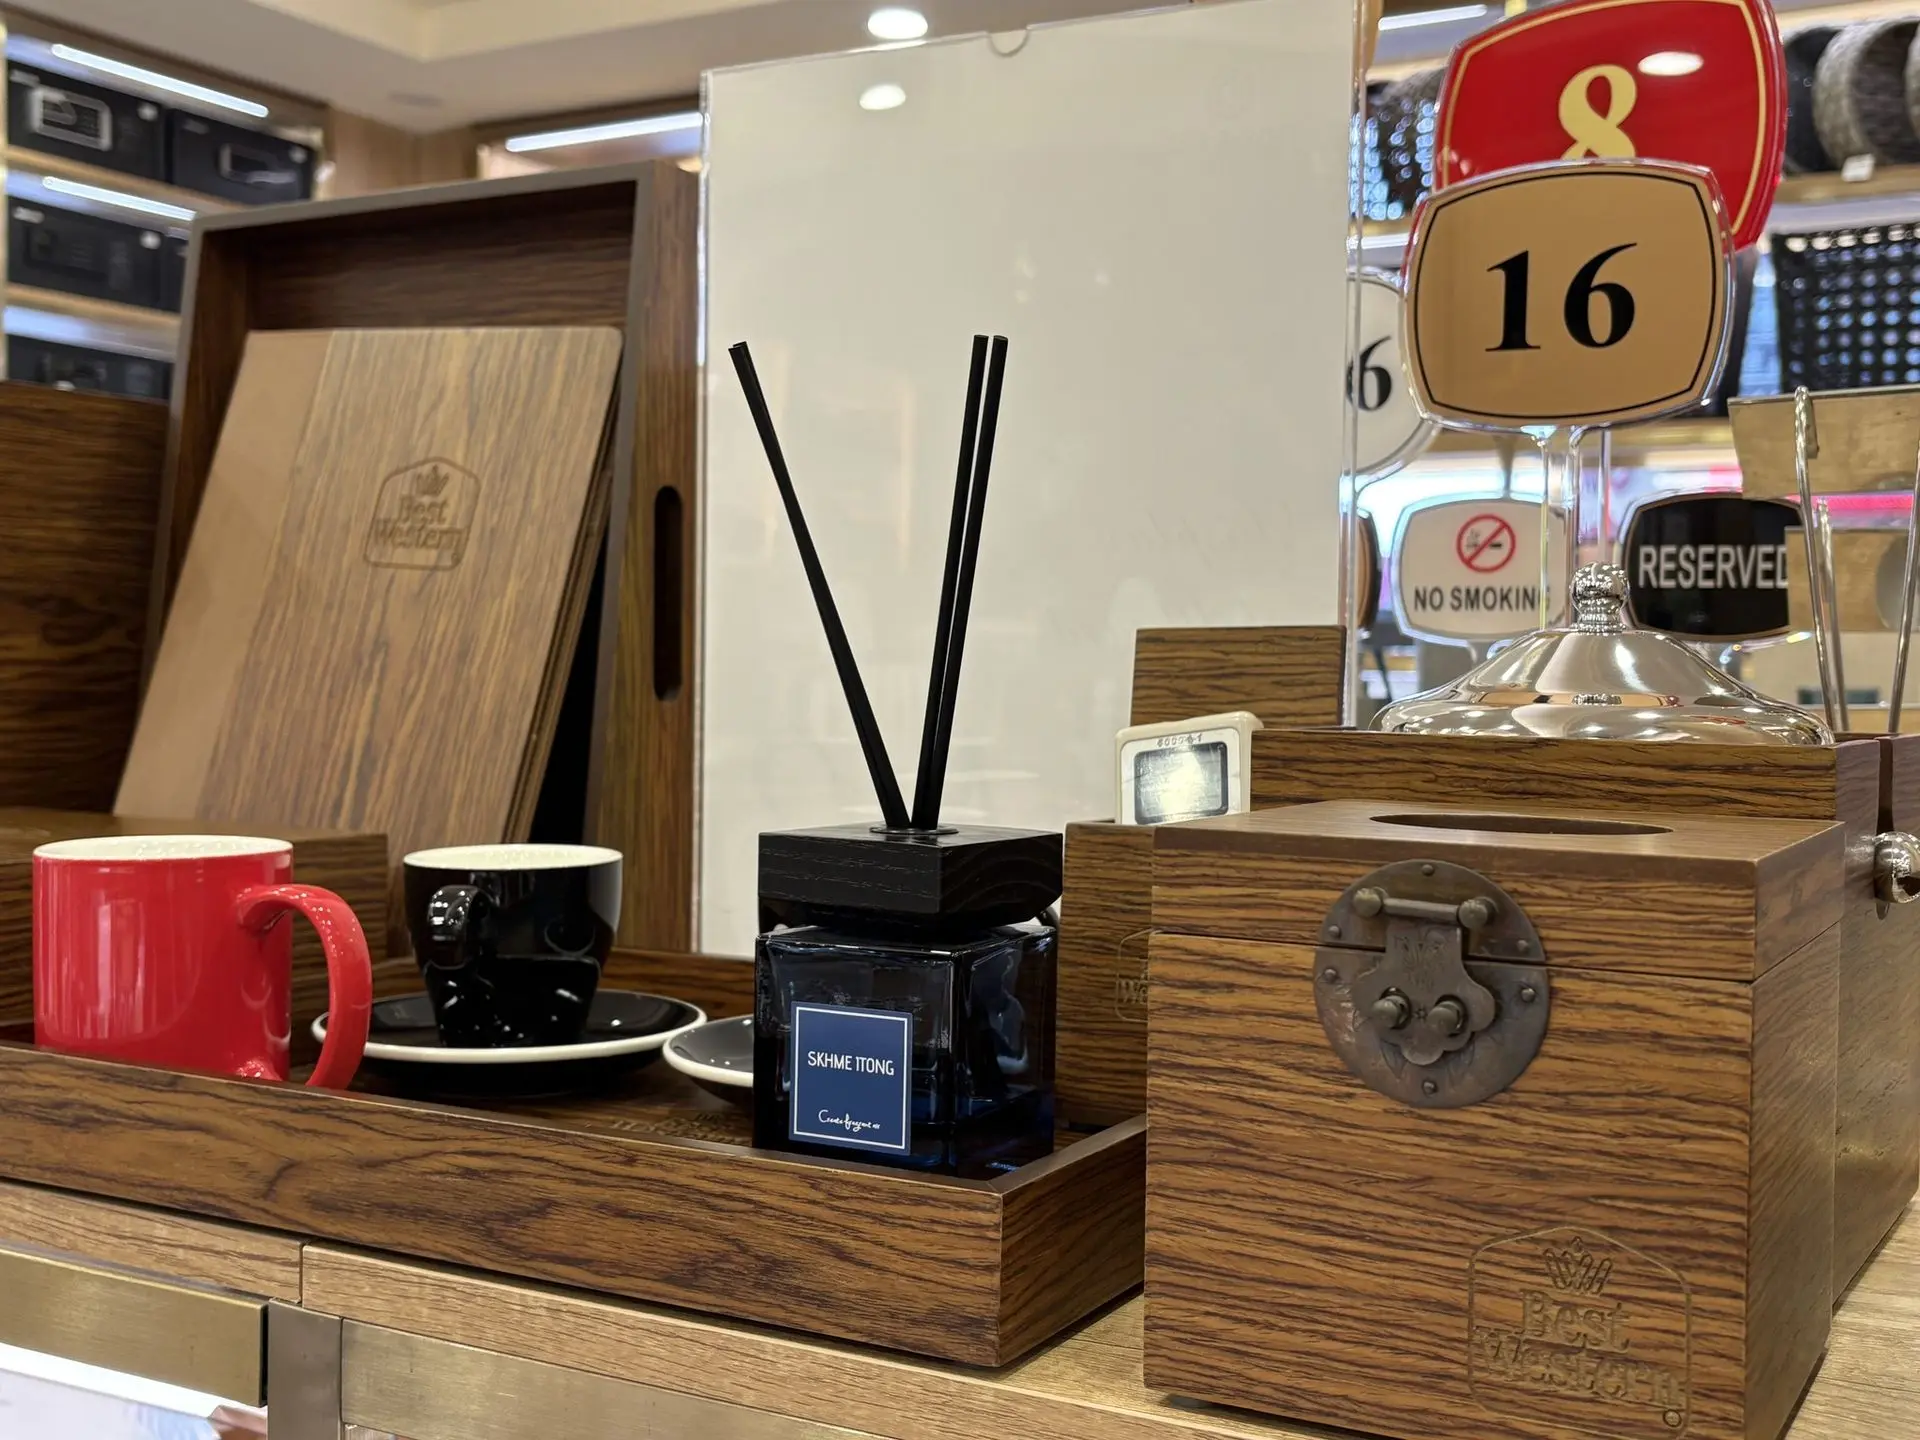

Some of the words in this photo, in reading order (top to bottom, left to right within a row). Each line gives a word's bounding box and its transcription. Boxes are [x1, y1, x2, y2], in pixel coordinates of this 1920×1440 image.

[1484, 242, 1638, 352] 16
[1638, 543, 1789, 590] RESERVED
[1414, 585, 1444, 612] NO
[807, 1050, 852, 1071] SKHME
[1520, 1288, 1632, 1353] Best
[1473, 1325, 1687, 1409] Western
